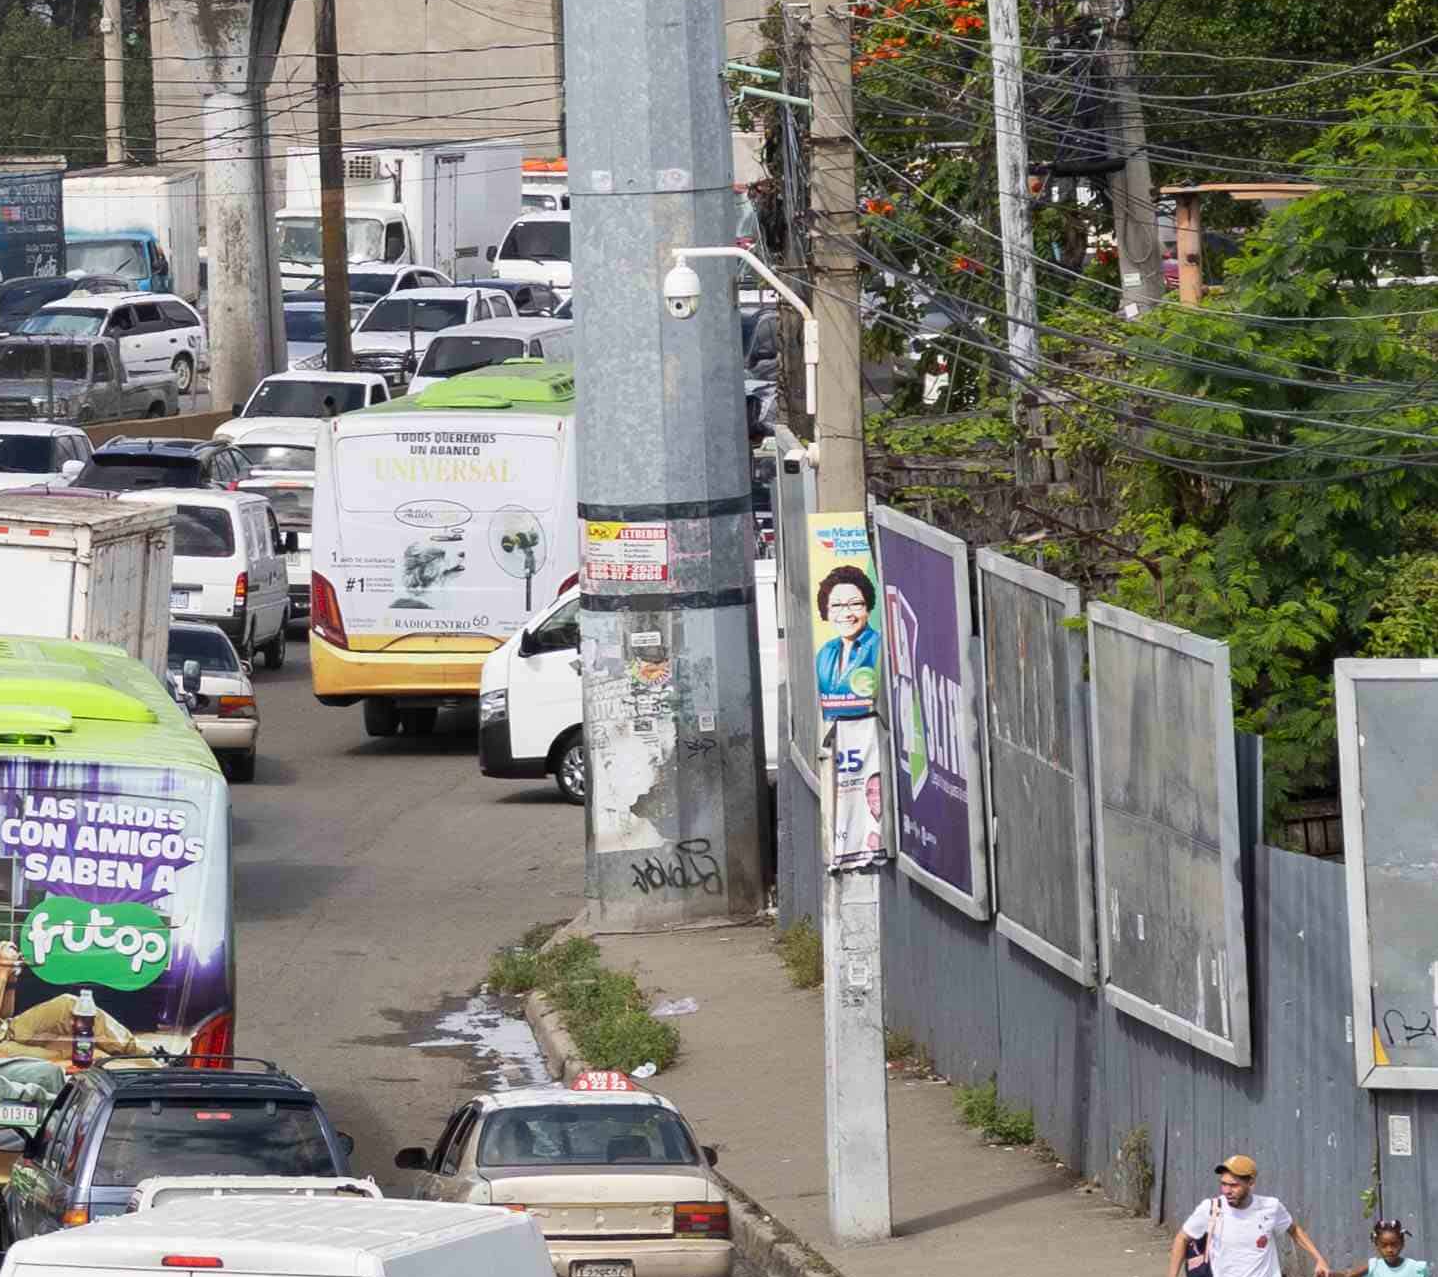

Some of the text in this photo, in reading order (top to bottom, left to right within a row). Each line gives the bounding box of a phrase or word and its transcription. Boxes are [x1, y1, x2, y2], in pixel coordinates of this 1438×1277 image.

[395, 432, 497, 444] TODOS QUEREMOS
[410, 445, 481, 456] UN ABANICO
[375, 457, 519, 484] UNIVERSAL
[345, 577, 366, 593] #1
[394, 614, 490, 631] RADIOCENTRO 60
[24, 795, 187, 832] LAS TARDES
[0, 820, 205, 862] CON AMIGOS
[24, 854, 177, 893] SABEN A
[27, 907, 169, 973] frutop
[587, 1072, 608, 1081] KM
[579, 1081, 588, 1091] 9
[591, 1081, 608, 1091] 22
